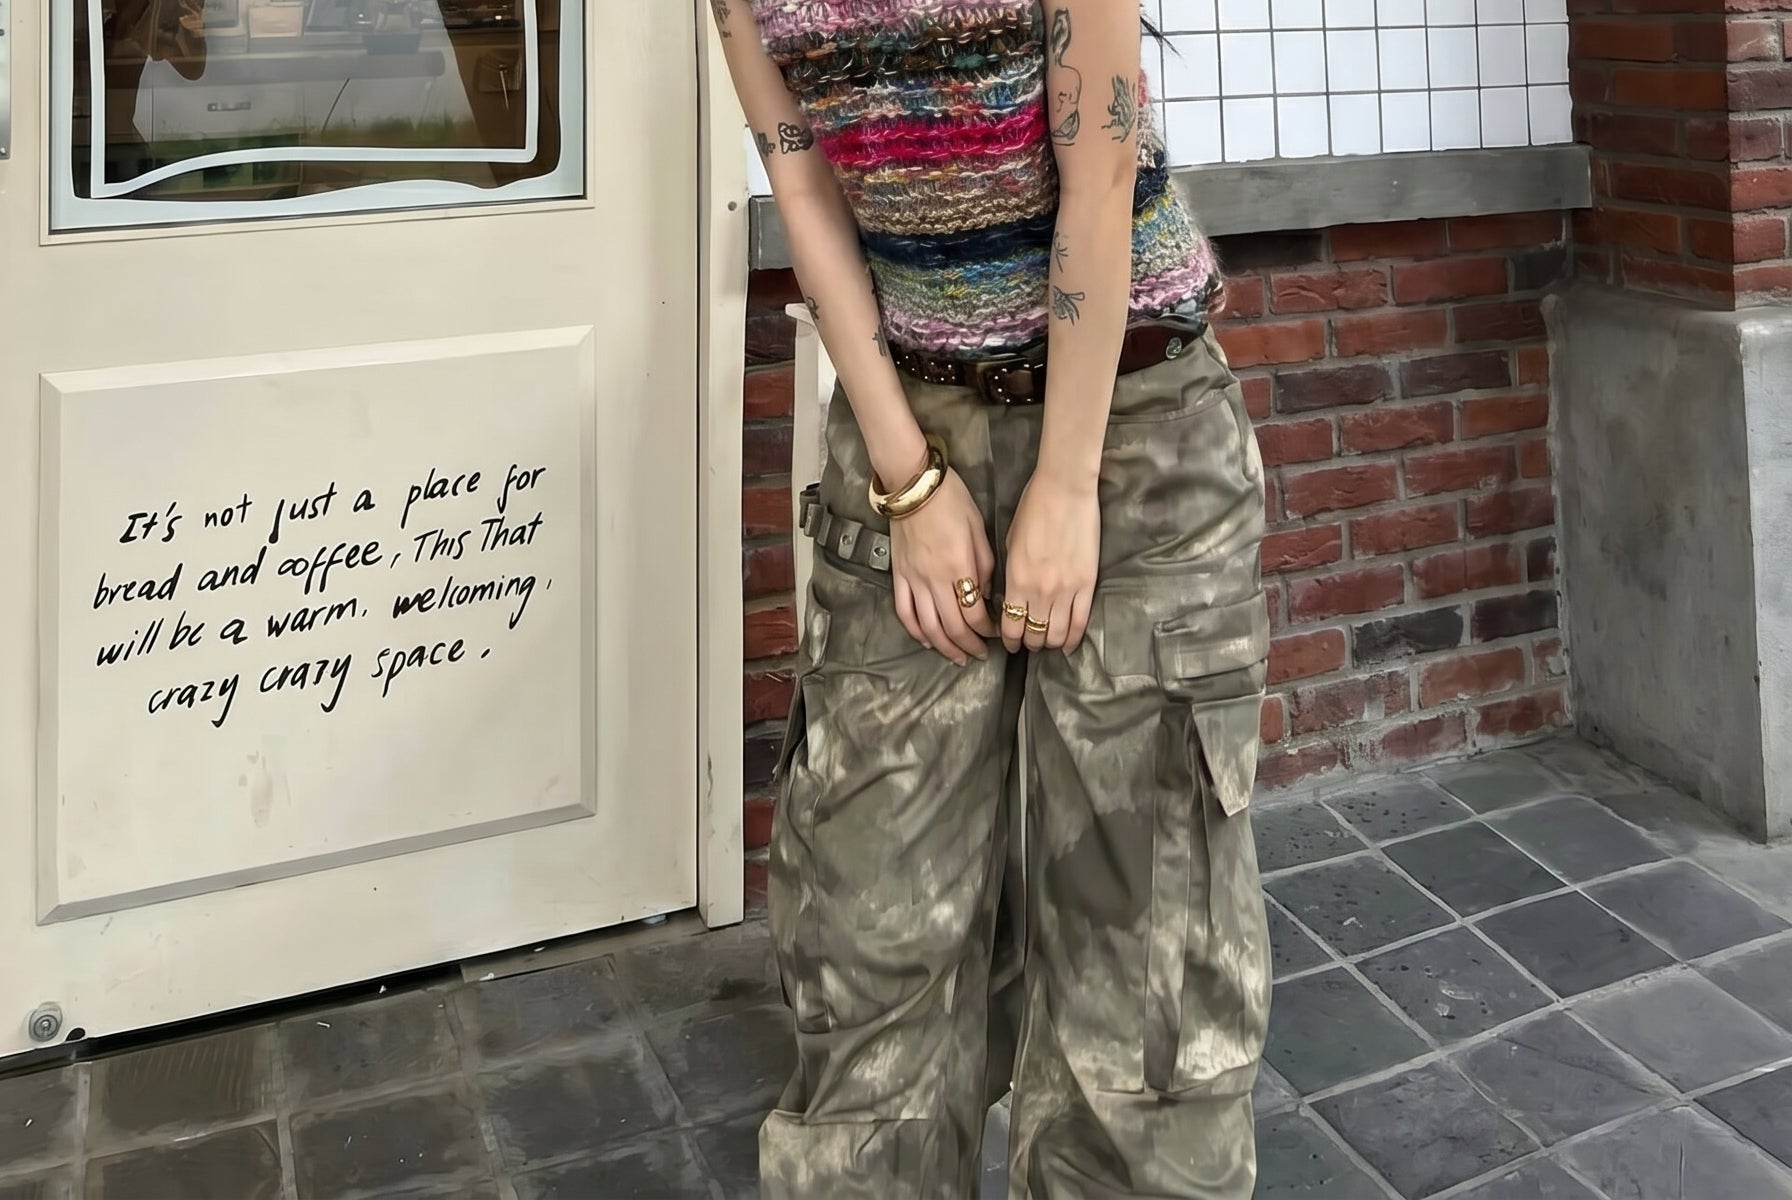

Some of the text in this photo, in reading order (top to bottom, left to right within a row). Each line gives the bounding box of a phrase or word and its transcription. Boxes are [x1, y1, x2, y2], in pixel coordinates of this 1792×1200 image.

[119, 463, 547, 545] It's not just a place for
[93, 562, 184, 610] bread
[197, 545, 268, 593] and
[413, 528, 472, 564] This
[480, 511, 544, 552] That
[96, 617, 165, 667] will
[168, 610, 205, 650] be
[219, 618, 248, 645] a
[148, 673, 239, 729] crazy
[259, 653, 352, 714] crazy
